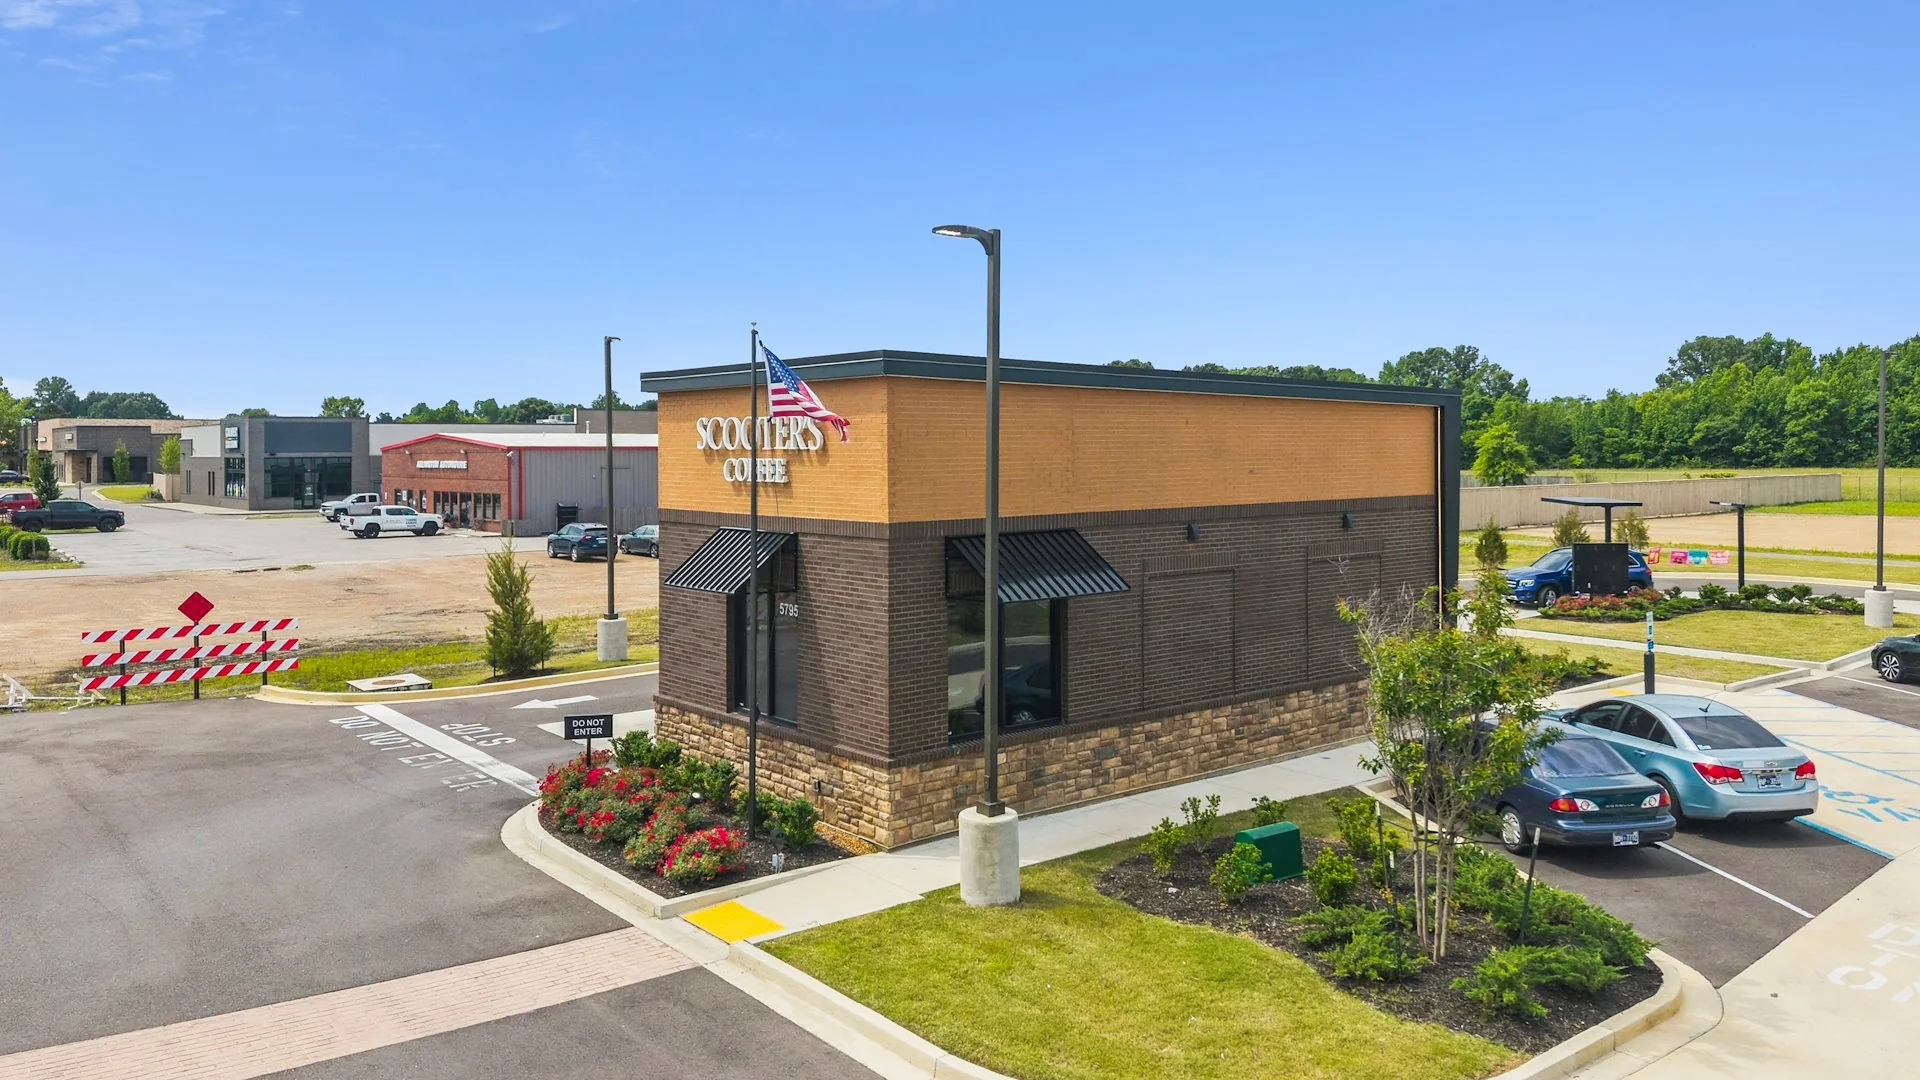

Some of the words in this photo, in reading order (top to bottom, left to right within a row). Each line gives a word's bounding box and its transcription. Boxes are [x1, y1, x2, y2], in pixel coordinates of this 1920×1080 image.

[696, 416, 824, 451] SCOOTER'S
[779, 603, 799, 617] 5795
[572, 719, 586, 728] DO
[586, 718, 605, 726] NOT
[574, 727, 603, 736] ENTER
[328, 715, 380, 730] DO
[356, 730, 424, 751] NOT
[440, 723, 517, 747] STOP
